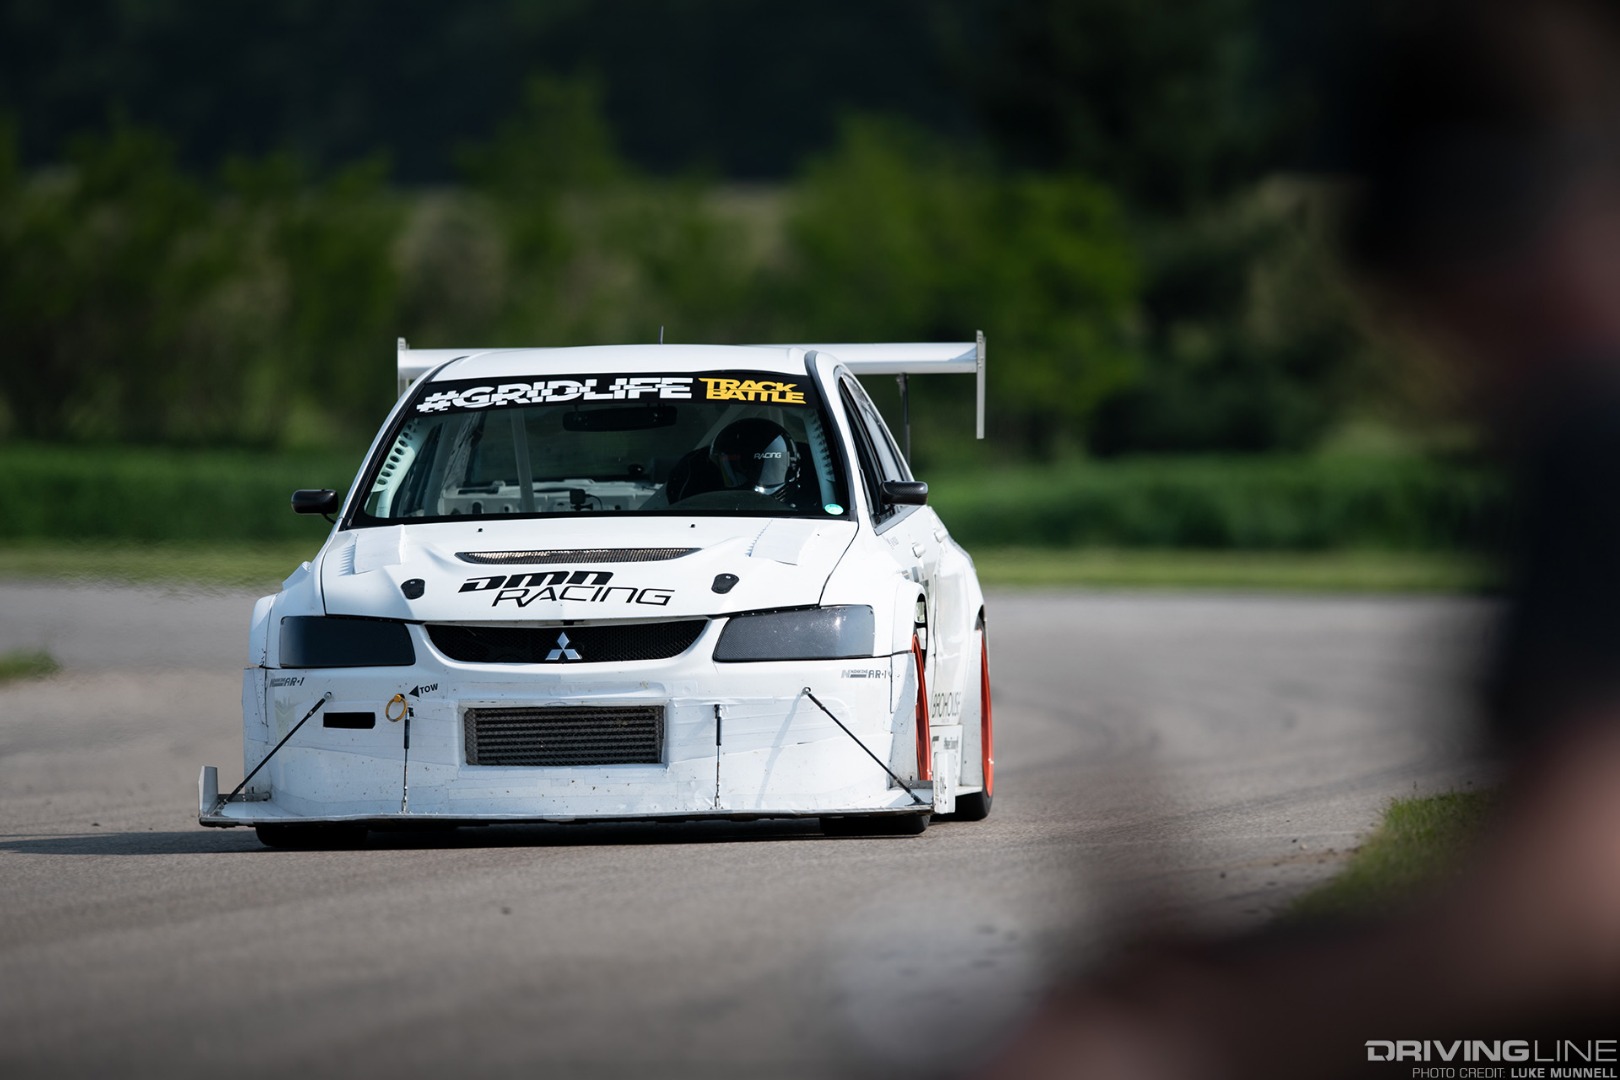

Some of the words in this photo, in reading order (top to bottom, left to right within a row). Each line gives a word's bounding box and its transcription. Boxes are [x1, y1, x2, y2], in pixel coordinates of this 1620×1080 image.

[698, 378, 798, 392] TRACK
[416, 377, 693, 413] #GRIDLIFE
[706, 389, 807, 404] BATTLE
[753, 452, 782, 460] RACING
[491, 585, 676, 608] RACING
[419, 683, 438, 694] TOW
